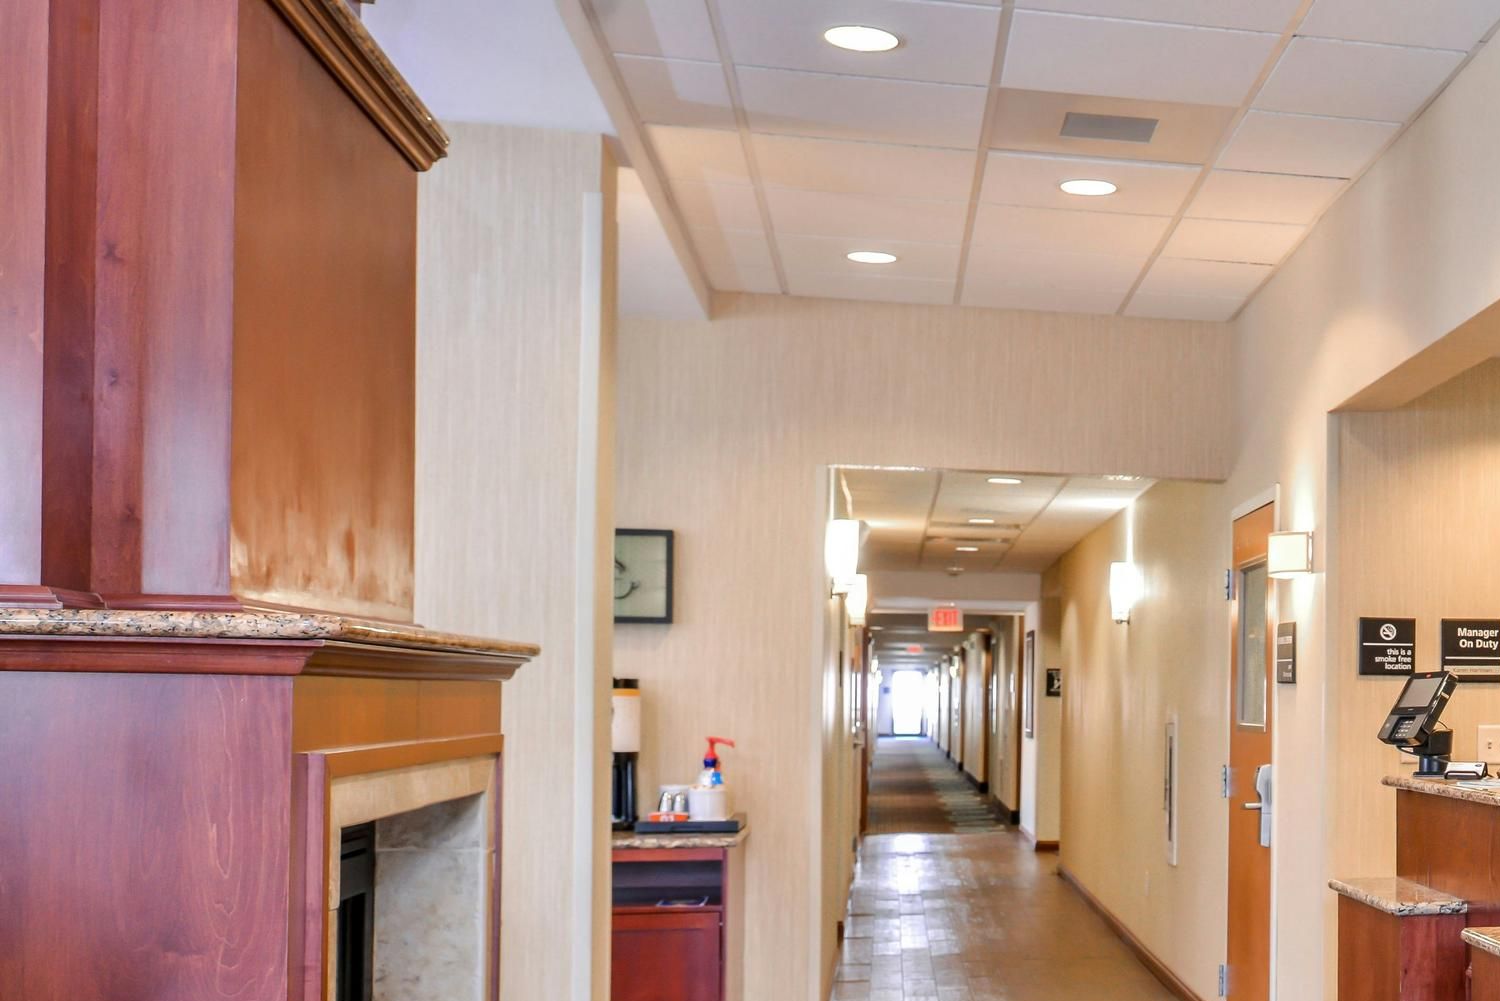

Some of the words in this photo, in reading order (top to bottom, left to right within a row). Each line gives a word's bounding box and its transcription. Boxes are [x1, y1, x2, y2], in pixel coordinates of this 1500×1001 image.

[935, 608, 959, 626] EXIT
[1457, 627, 1499, 639] Manager
[1459, 638, 1474, 648] On
[1475, 639, 1499, 650] Duty
[1375, 655, 1397, 663] smoke
[1398, 655, 1412, 663] free
[1384, 662, 1412, 670] location
